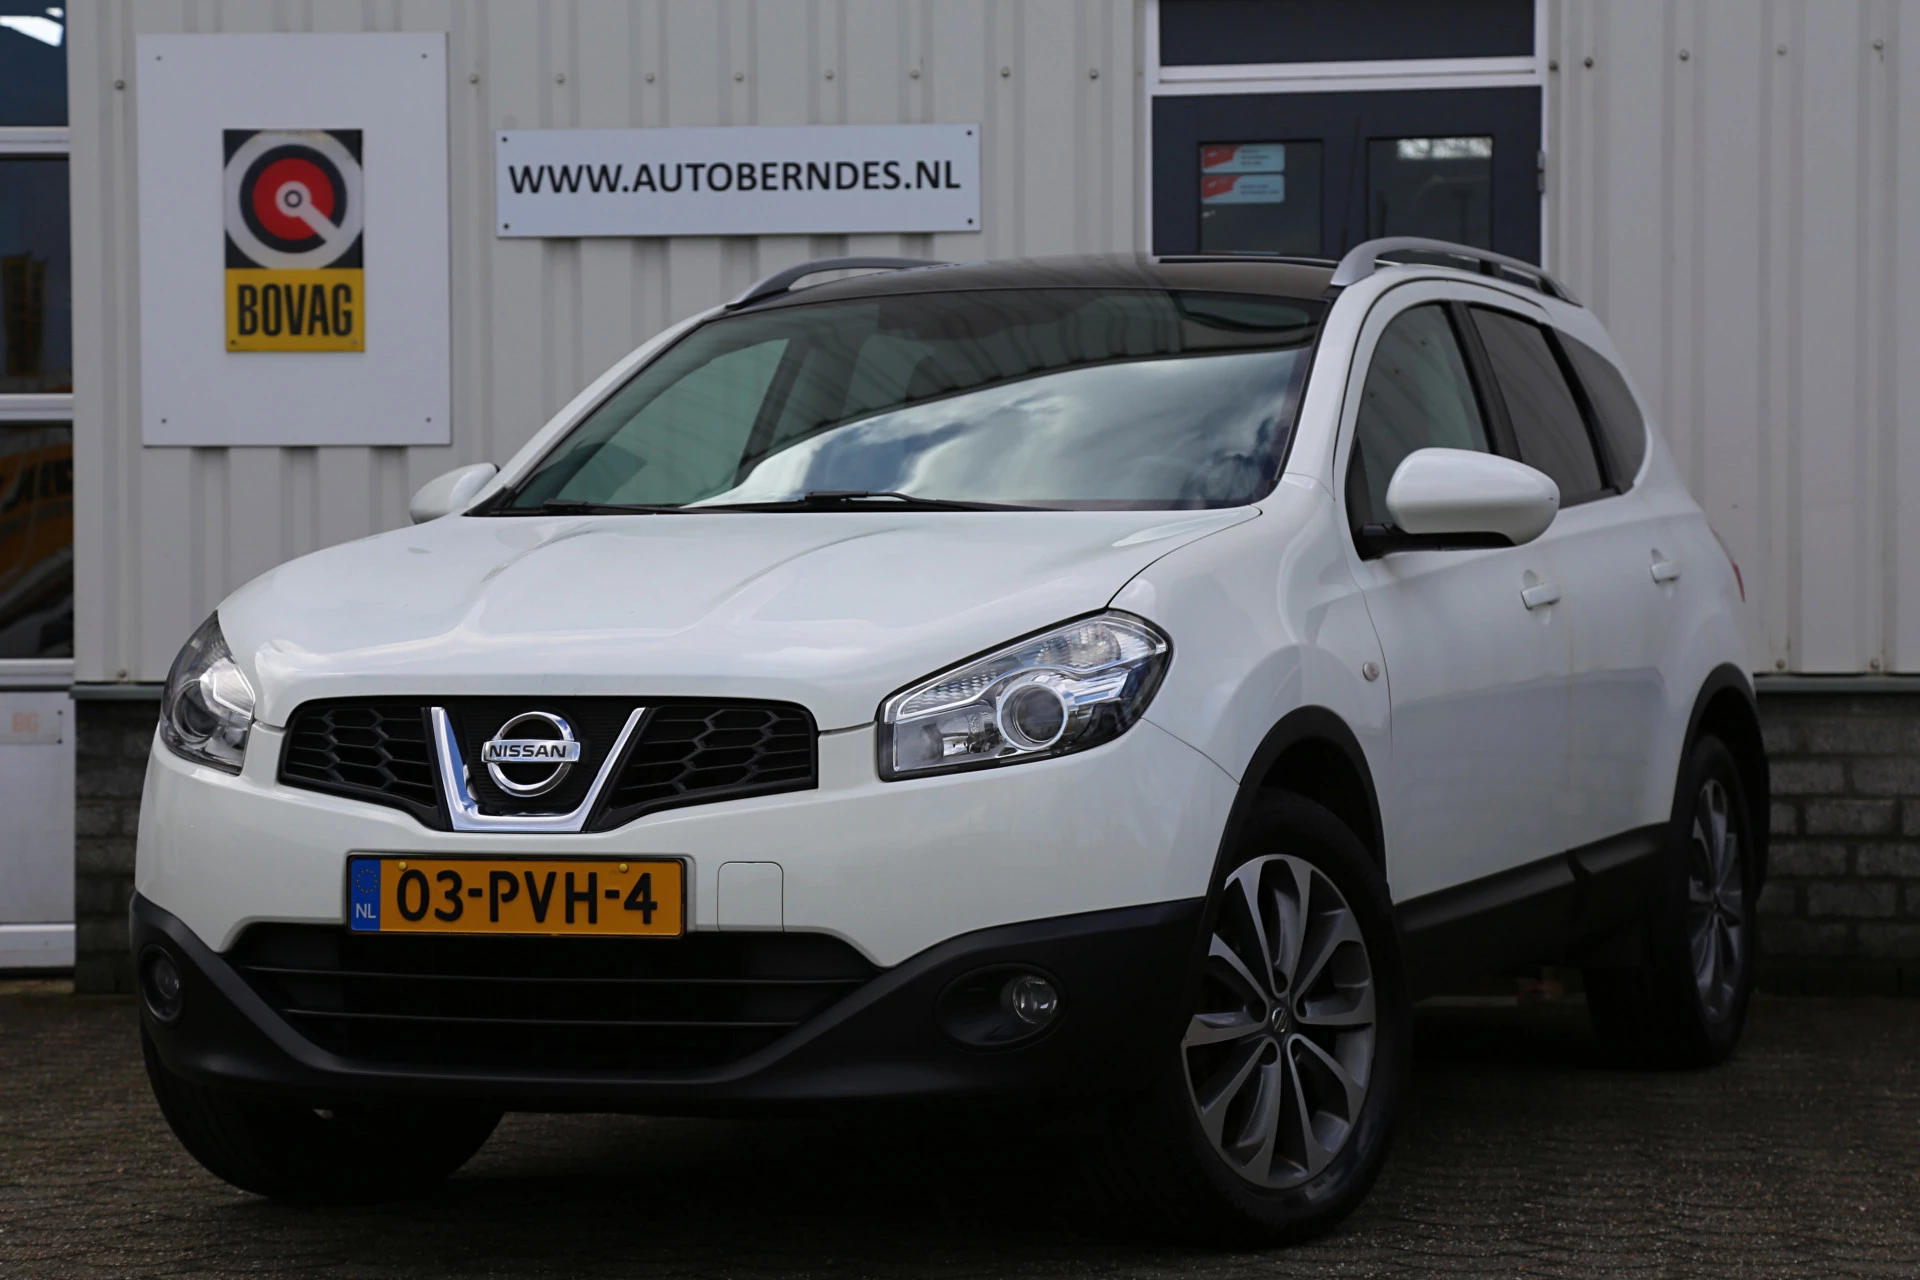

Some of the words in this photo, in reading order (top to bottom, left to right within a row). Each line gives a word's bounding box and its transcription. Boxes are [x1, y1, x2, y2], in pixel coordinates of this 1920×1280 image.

[508, 160, 961, 194] WWW.AUTOBERNDES.NL
[237, 283, 353, 337] BOVAG
[489, 744, 567, 758] NISSAN
[355, 903, 377, 919] NL
[397, 869, 658, 925] 03-PVH-4
